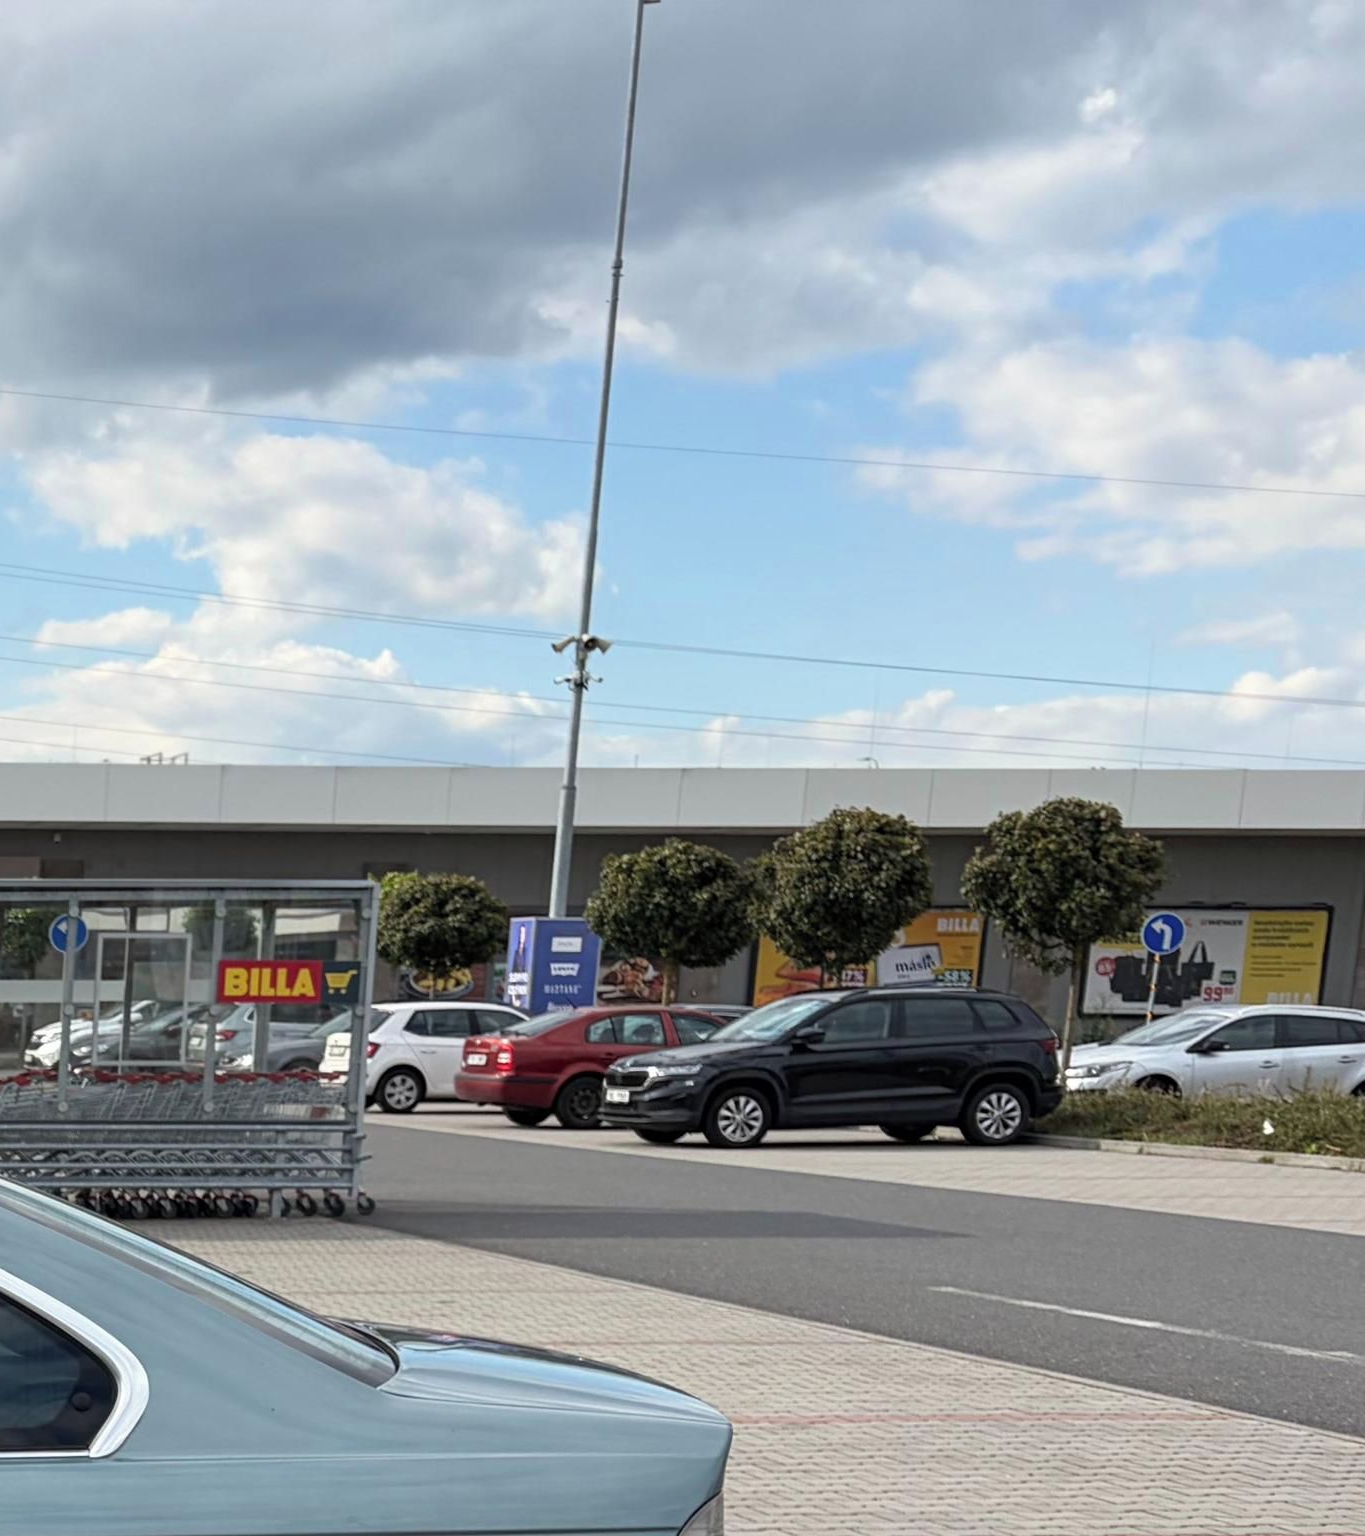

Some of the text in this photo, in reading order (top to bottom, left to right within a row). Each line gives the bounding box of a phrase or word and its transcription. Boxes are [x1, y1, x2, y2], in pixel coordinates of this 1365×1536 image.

[936, 917, 980, 932] BILLA
[224, 967, 316, 997] BILLA
[1204, 986, 1223, 1002] 99
